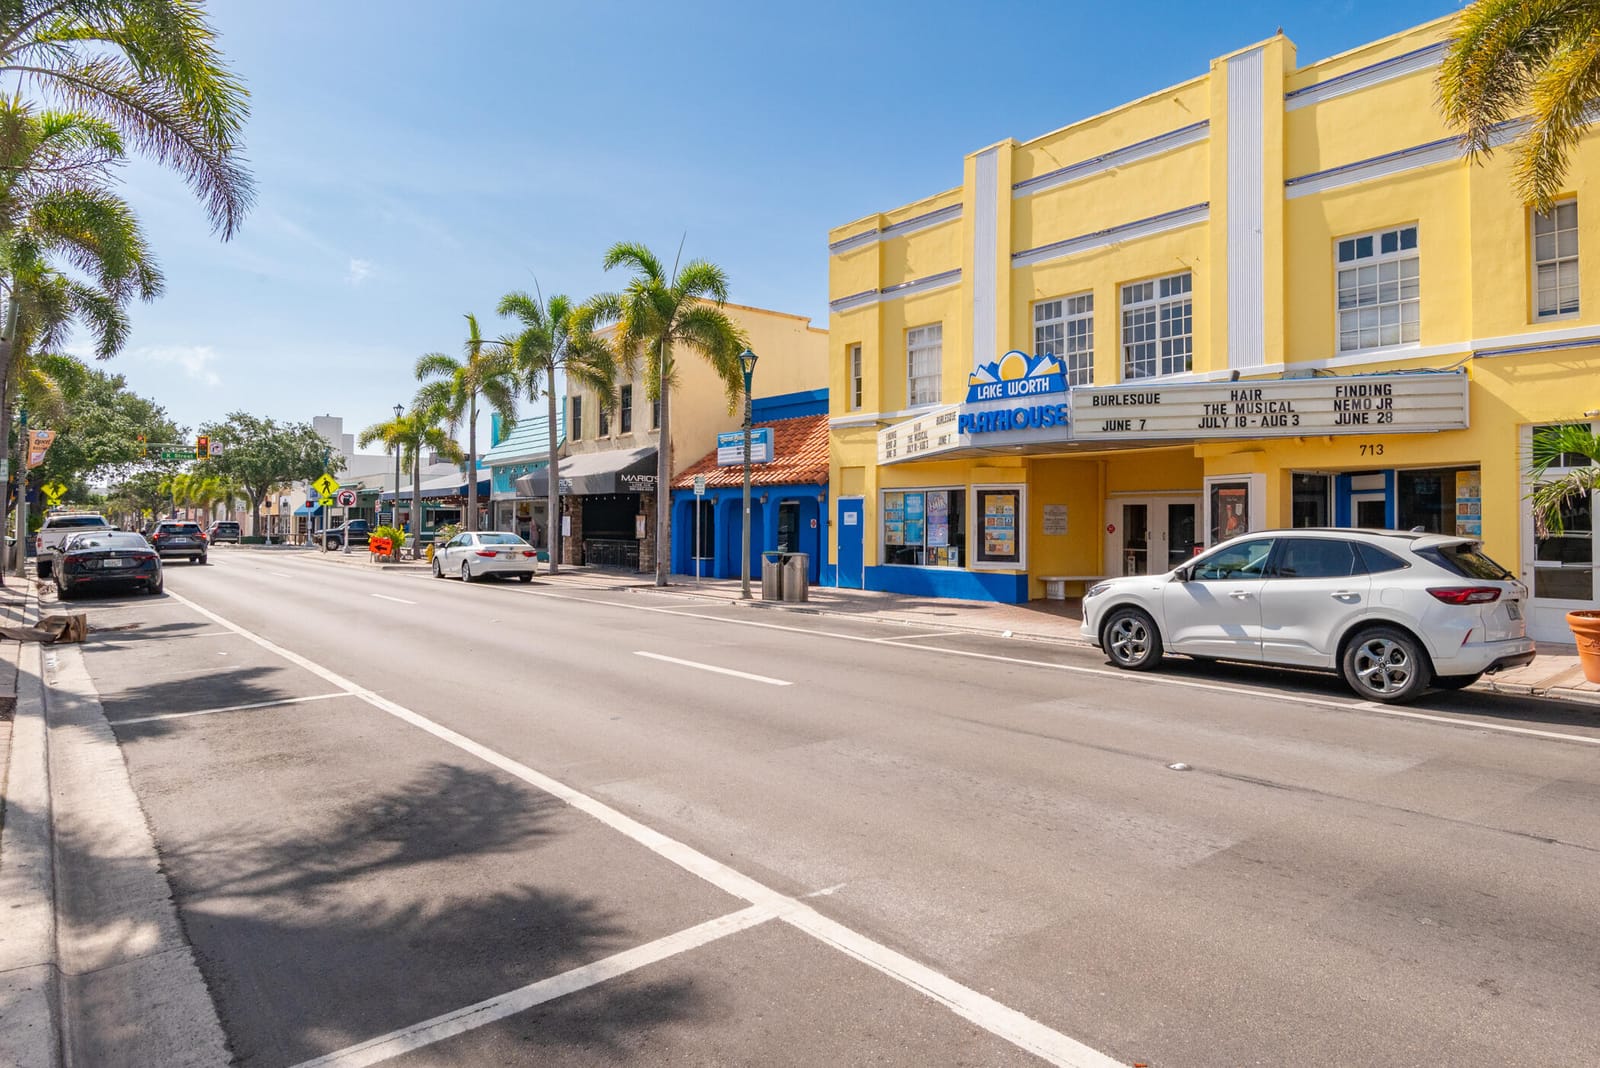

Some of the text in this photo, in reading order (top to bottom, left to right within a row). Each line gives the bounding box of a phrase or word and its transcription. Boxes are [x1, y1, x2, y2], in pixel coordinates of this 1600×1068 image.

[977, 377, 1050, 400] LAKE WORTH
[1231, 389, 1262, 401] HAIR
[1092, 393, 1160, 407] BURLESQUE
[1333, 398, 1393, 411] NEMO JR
[1203, 401, 1295, 416] THE MUSICAL
[958, 404, 1068, 434] PLAYHOUSE
[1198, 417, 1229, 429] JULY
[1234, 416, 1247, 428] 18
[1260, 415, 1288, 427] AUG
[1292, 414, 1300, 426] 3
[1335, 411, 1393, 425] JUNE 28
[1102, 419, 1146, 432] JUNE 7
[1359, 444, 1384, 456] 713
